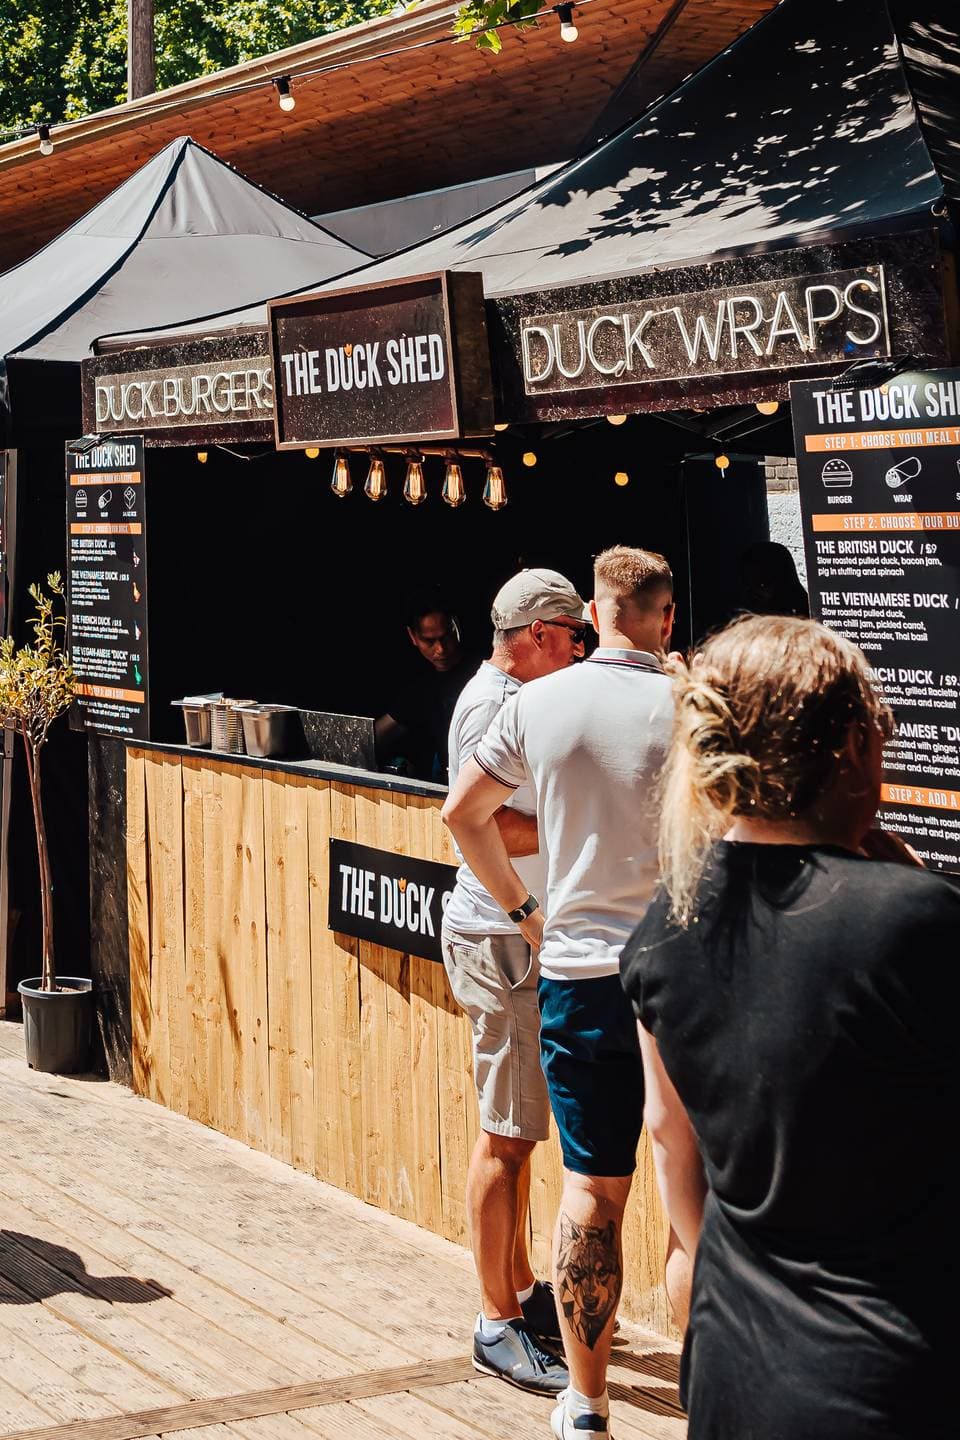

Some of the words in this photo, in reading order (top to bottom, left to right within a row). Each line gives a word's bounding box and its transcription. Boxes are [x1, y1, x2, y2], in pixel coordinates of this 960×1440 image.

[522, 311, 655, 382] DUCK
[674, 279, 881, 366] WRAPS
[281, 350, 322, 396] THE
[325, 342, 383, 392] DUCK
[386, 333, 445, 386] SHED
[96, 381, 157, 423] DUCK
[163, 368, 274, 417] BURGERS
[812, 391, 855, 424] THE
[859, 384, 920, 421] DUCK
[824, 438, 846, 449] STEP
[850, 437, 858, 448] 1:
[861, 435, 895, 448] CHOOSE
[899, 432, 923, 445] YOUR
[926, 430, 952, 444] MEAL
[91, 446, 113, 468] DUCK
[114, 444, 136, 466] SHED
[827, 495, 852, 504] BURGER
[893, 494, 913, 503] WRAP
[844, 517, 866, 529] STEP
[868, 517, 878, 528] 2:
[880, 516, 916, 529] CHOOSE
[918, 516, 943, 528] YOUR
[815, 540, 836, 554] THE
[837, 540, 877, 554] BRITISH
[880, 540, 915, 554] DUCK
[817, 557, 832, 565] Slow
[832, 556, 858, 566] roasted
[858, 556, 880, 567] pulled
[880, 556, 900, 566] duck,
[900, 557, 924, 566] bacon
[925, 557, 942, 566] jam,
[818, 568, 829, 577] pig
[837, 567, 862, 577] stuffing
[862, 567, 877, 576] and
[877, 567, 904, 577] spinach
[820, 591, 840, 605] THE
[841, 592, 911, 608] VIETNAMESE
[913, 594, 950, 608] DUCK
[821, 608, 836, 616] Slow
[837, 608, 862, 617] roasted
[863, 609, 885, 618] pulled
[885, 610, 905, 619] duck,
[876, 620, 901, 630] pickled
[902, 622, 927, 631] carrot,
[860, 631, 895, 641] coriander,
[895, 632, 910, 641] Thai
[910, 633, 928, 641] basil
[863, 668, 896, 682] ENCH
[898, 668, 934, 685] DUCK
[884, 684, 905, 695] duck,
[917, 699, 933, 707] and
[941, 726, 960, 741] "DU
[916, 742, 932, 750] with
[932, 743, 958, 753] ginger,
[914, 752, 931, 762] jam,
[931, 754, 959, 764] pickled
[907, 764, 922, 772] and
[922, 765, 944, 776] crispy
[889, 787, 912, 800] STEP
[914, 792, 925, 803] 3:
[928, 792, 947, 806] ADD
[950, 794, 958, 807] A
[884, 811, 908, 820] potato
[924, 816, 939, 826] with
[880, 821, 914, 834] Szechuan
[914, 826, 928, 836] salt
[928, 829, 944, 838] and
[930, 851, 958, 863] cheese
[339, 864, 375, 920] THE
[380, 874, 436, 938] DUCK
